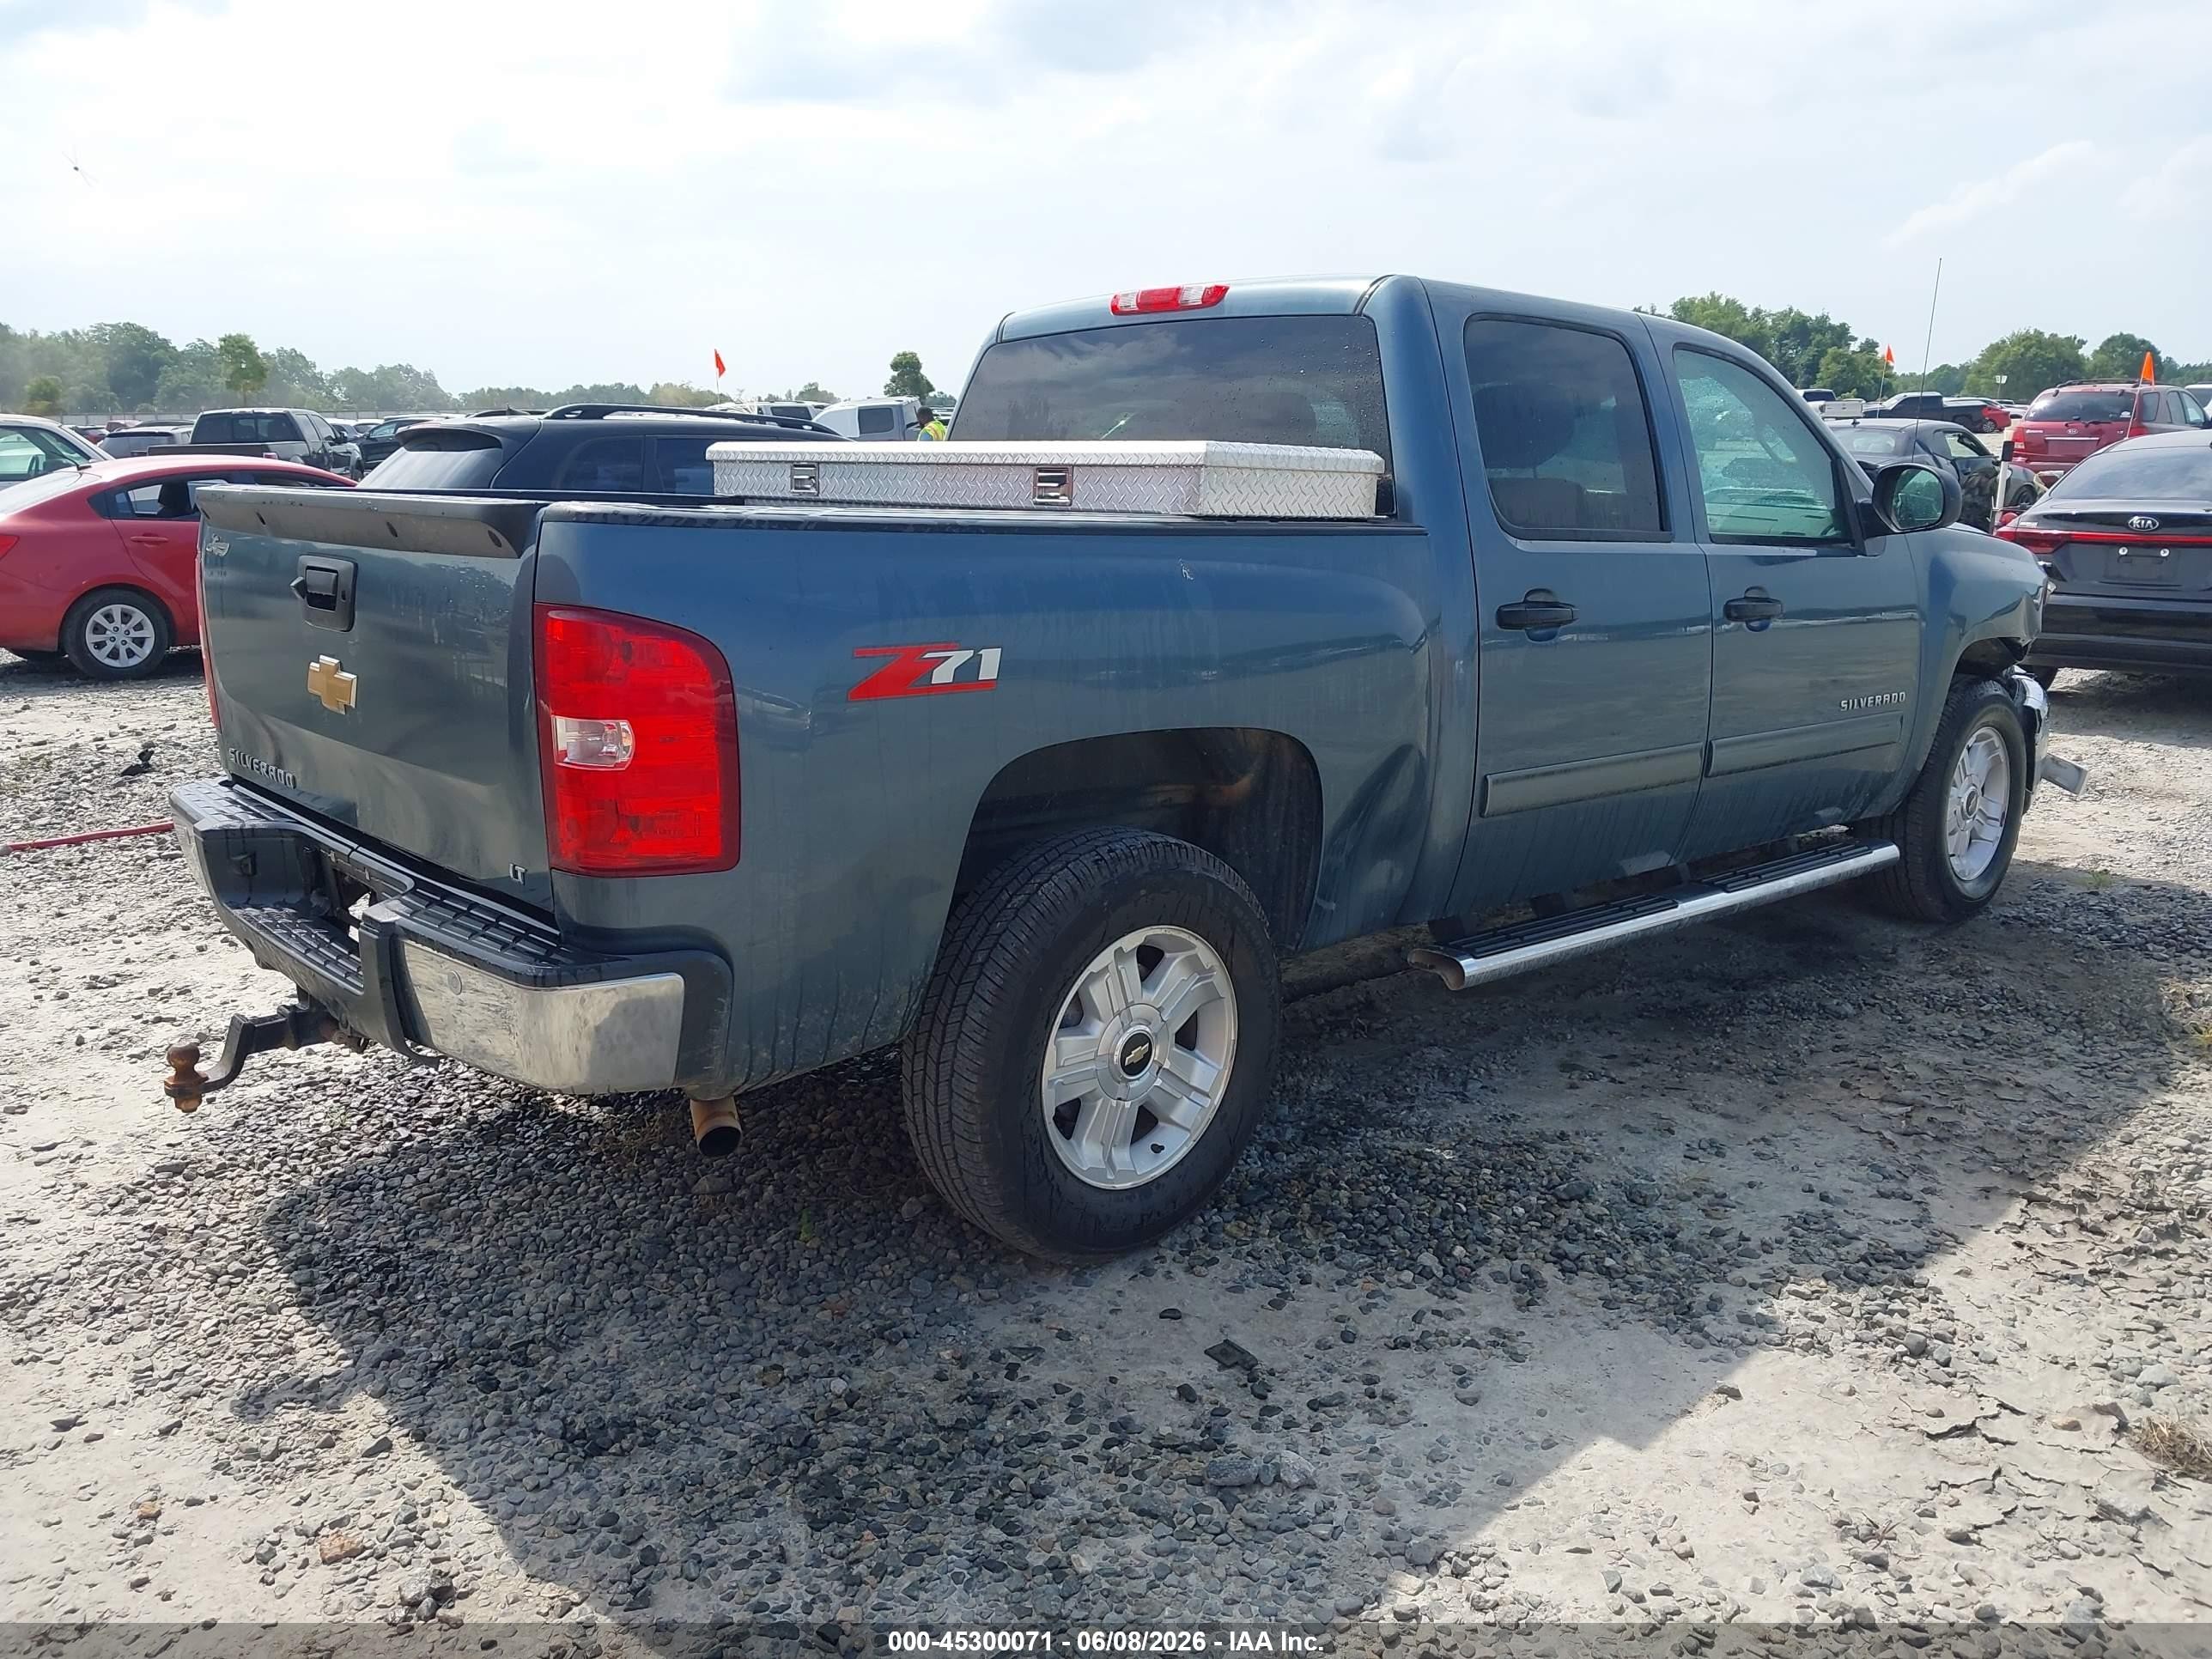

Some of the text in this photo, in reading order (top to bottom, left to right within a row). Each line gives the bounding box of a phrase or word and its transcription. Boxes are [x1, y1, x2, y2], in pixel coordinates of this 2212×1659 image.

[2130, 517, 2155, 530] KIA
[848, 642, 1002, 701] Z71
[1840, 691, 1905, 711] SILVERADO
[229, 748, 297, 789] SILVERADO
[509, 863, 526, 884] LT
